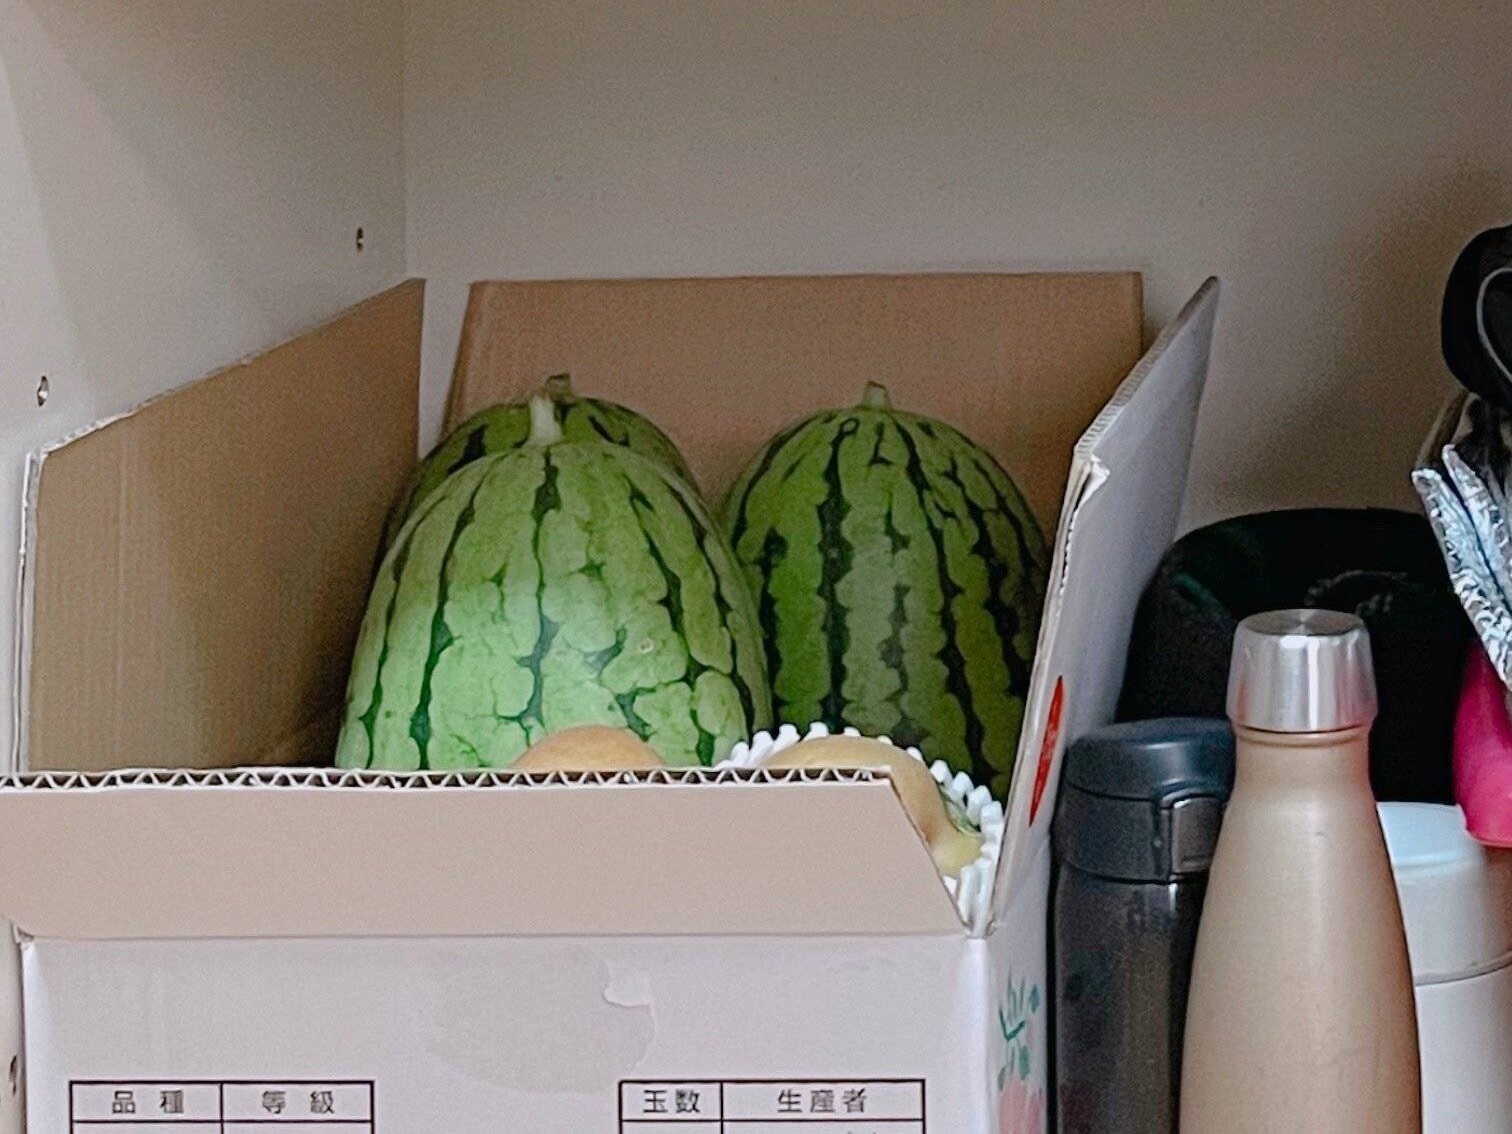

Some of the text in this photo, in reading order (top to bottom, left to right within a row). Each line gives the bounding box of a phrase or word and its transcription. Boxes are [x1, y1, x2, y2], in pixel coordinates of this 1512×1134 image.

[261, 1089, 335, 1115] 等級
[642, 1088, 701, 1114] 玉数
[776, 1087, 868, 1114] 生産者
